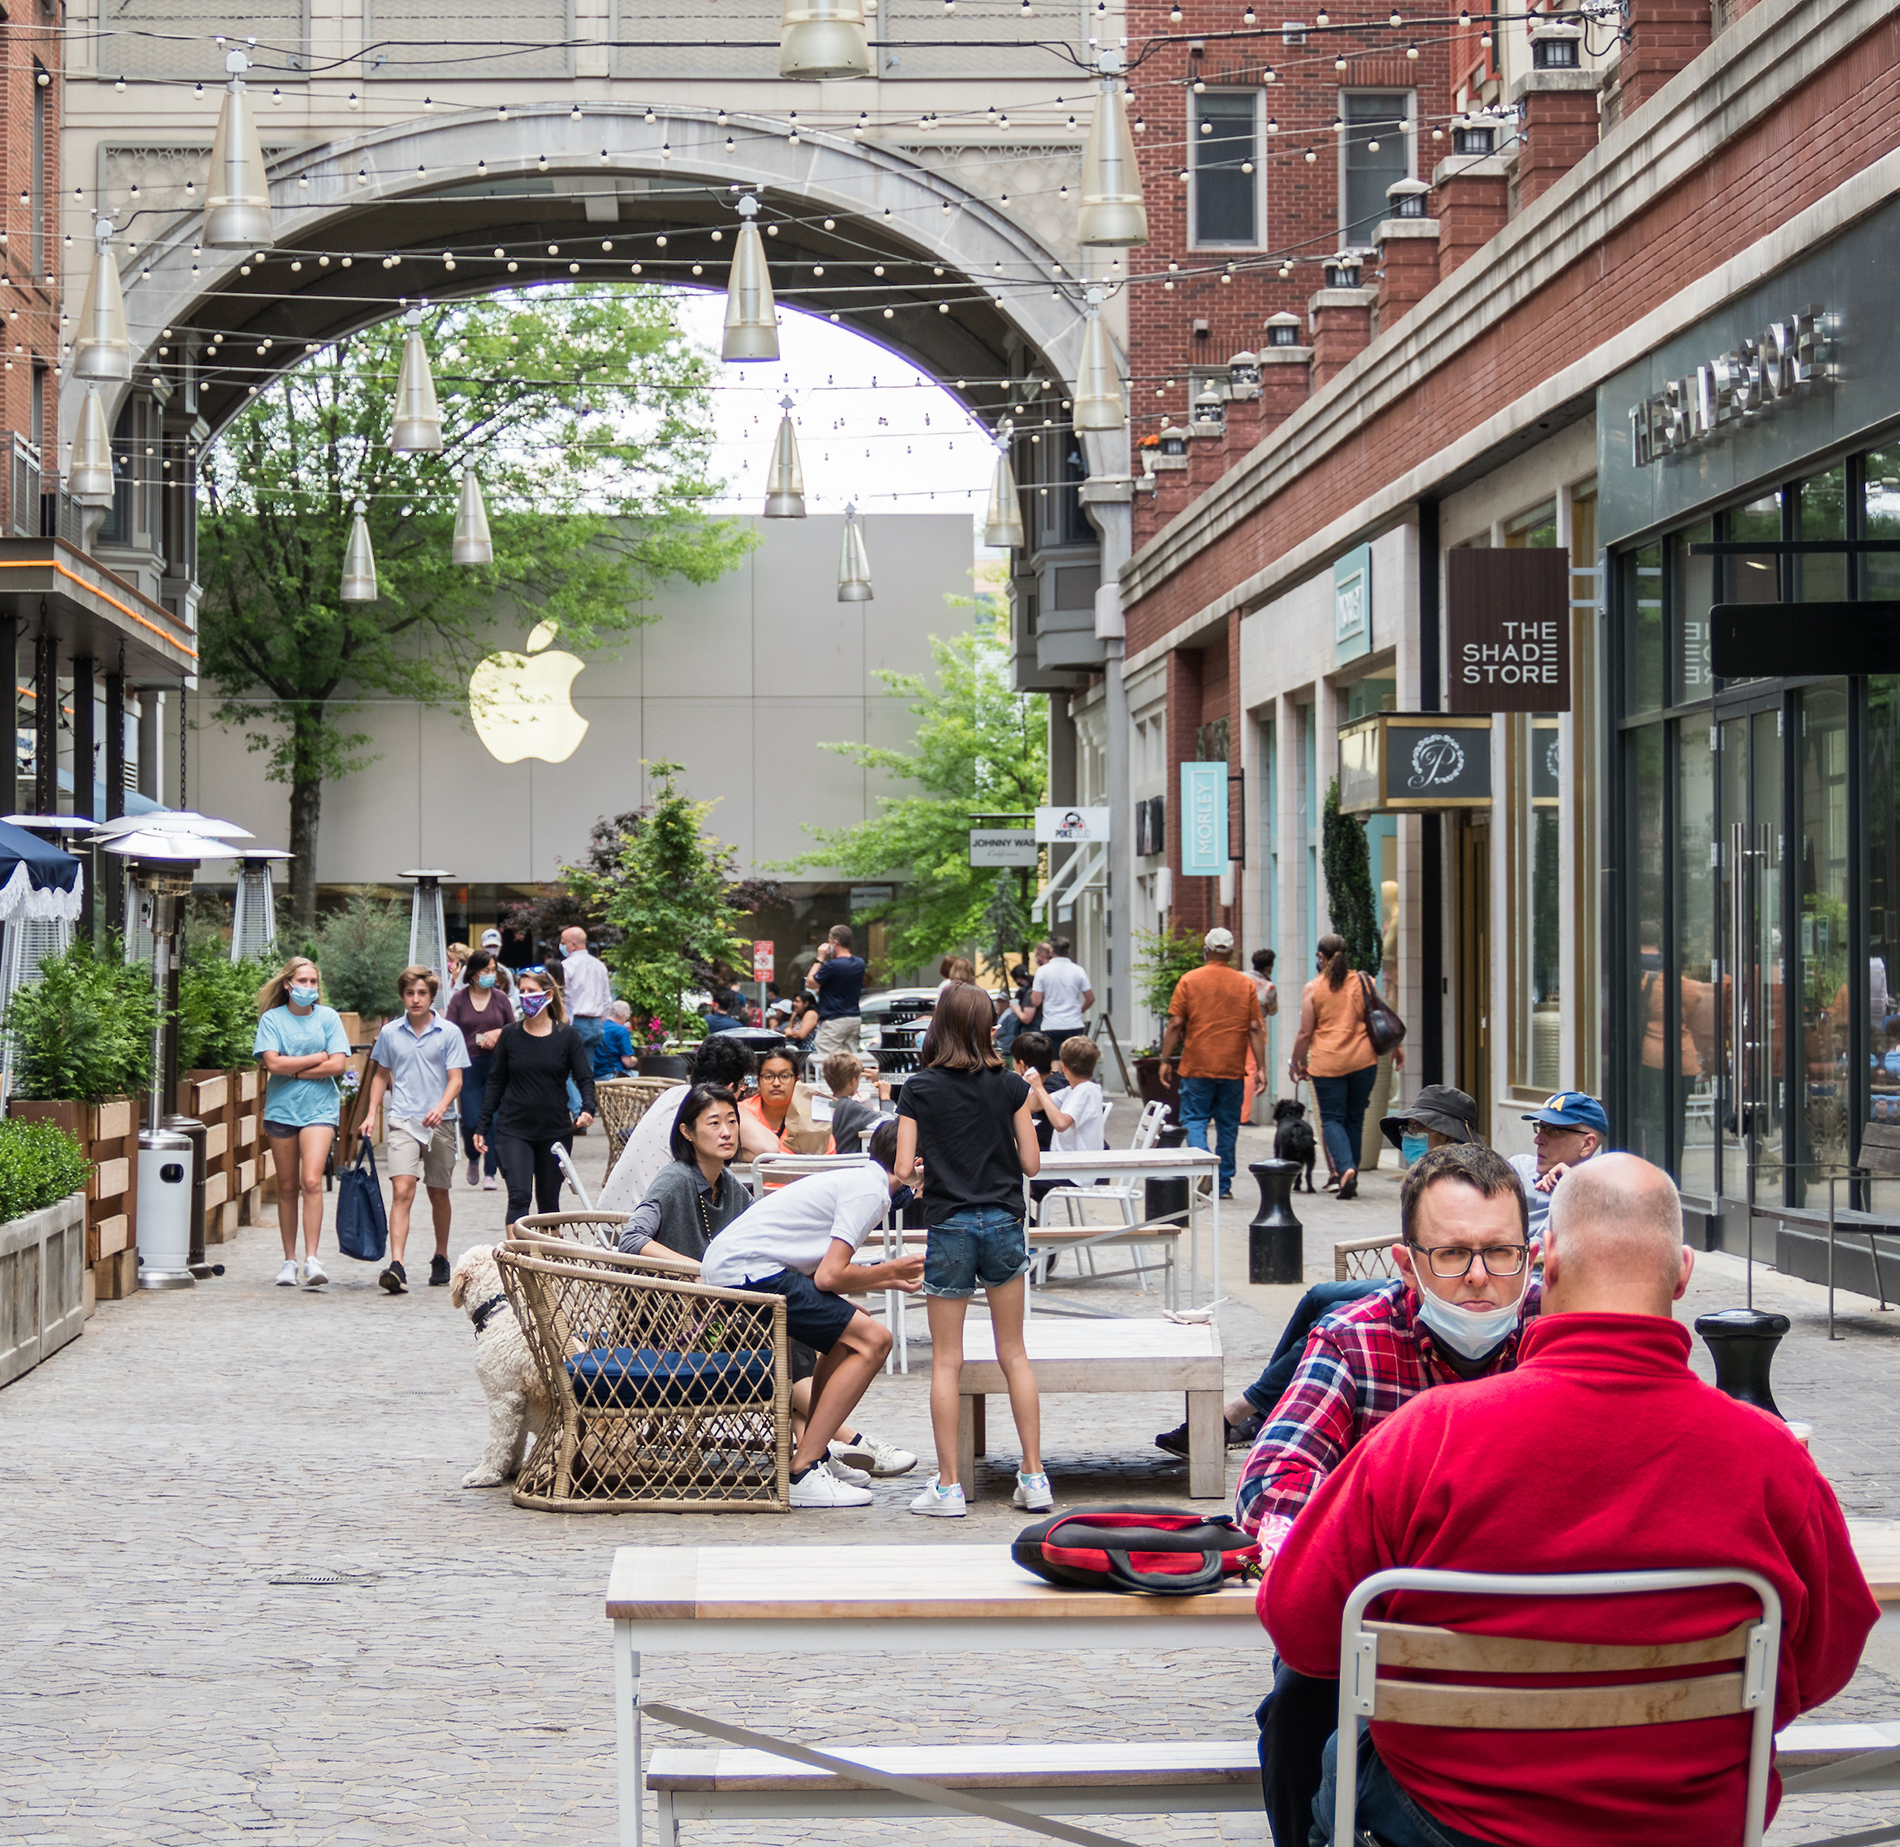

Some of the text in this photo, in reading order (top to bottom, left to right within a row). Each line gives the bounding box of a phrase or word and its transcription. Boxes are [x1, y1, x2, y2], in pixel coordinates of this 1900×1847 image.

[1502, 622, 1557, 640] THE
[1463, 643, 1558, 662] SHADE
[1463, 665, 1558, 684] STORE
[1197, 783, 1213, 855] MORLEY
[972, 838, 1036, 847] JOHNNY WAS
